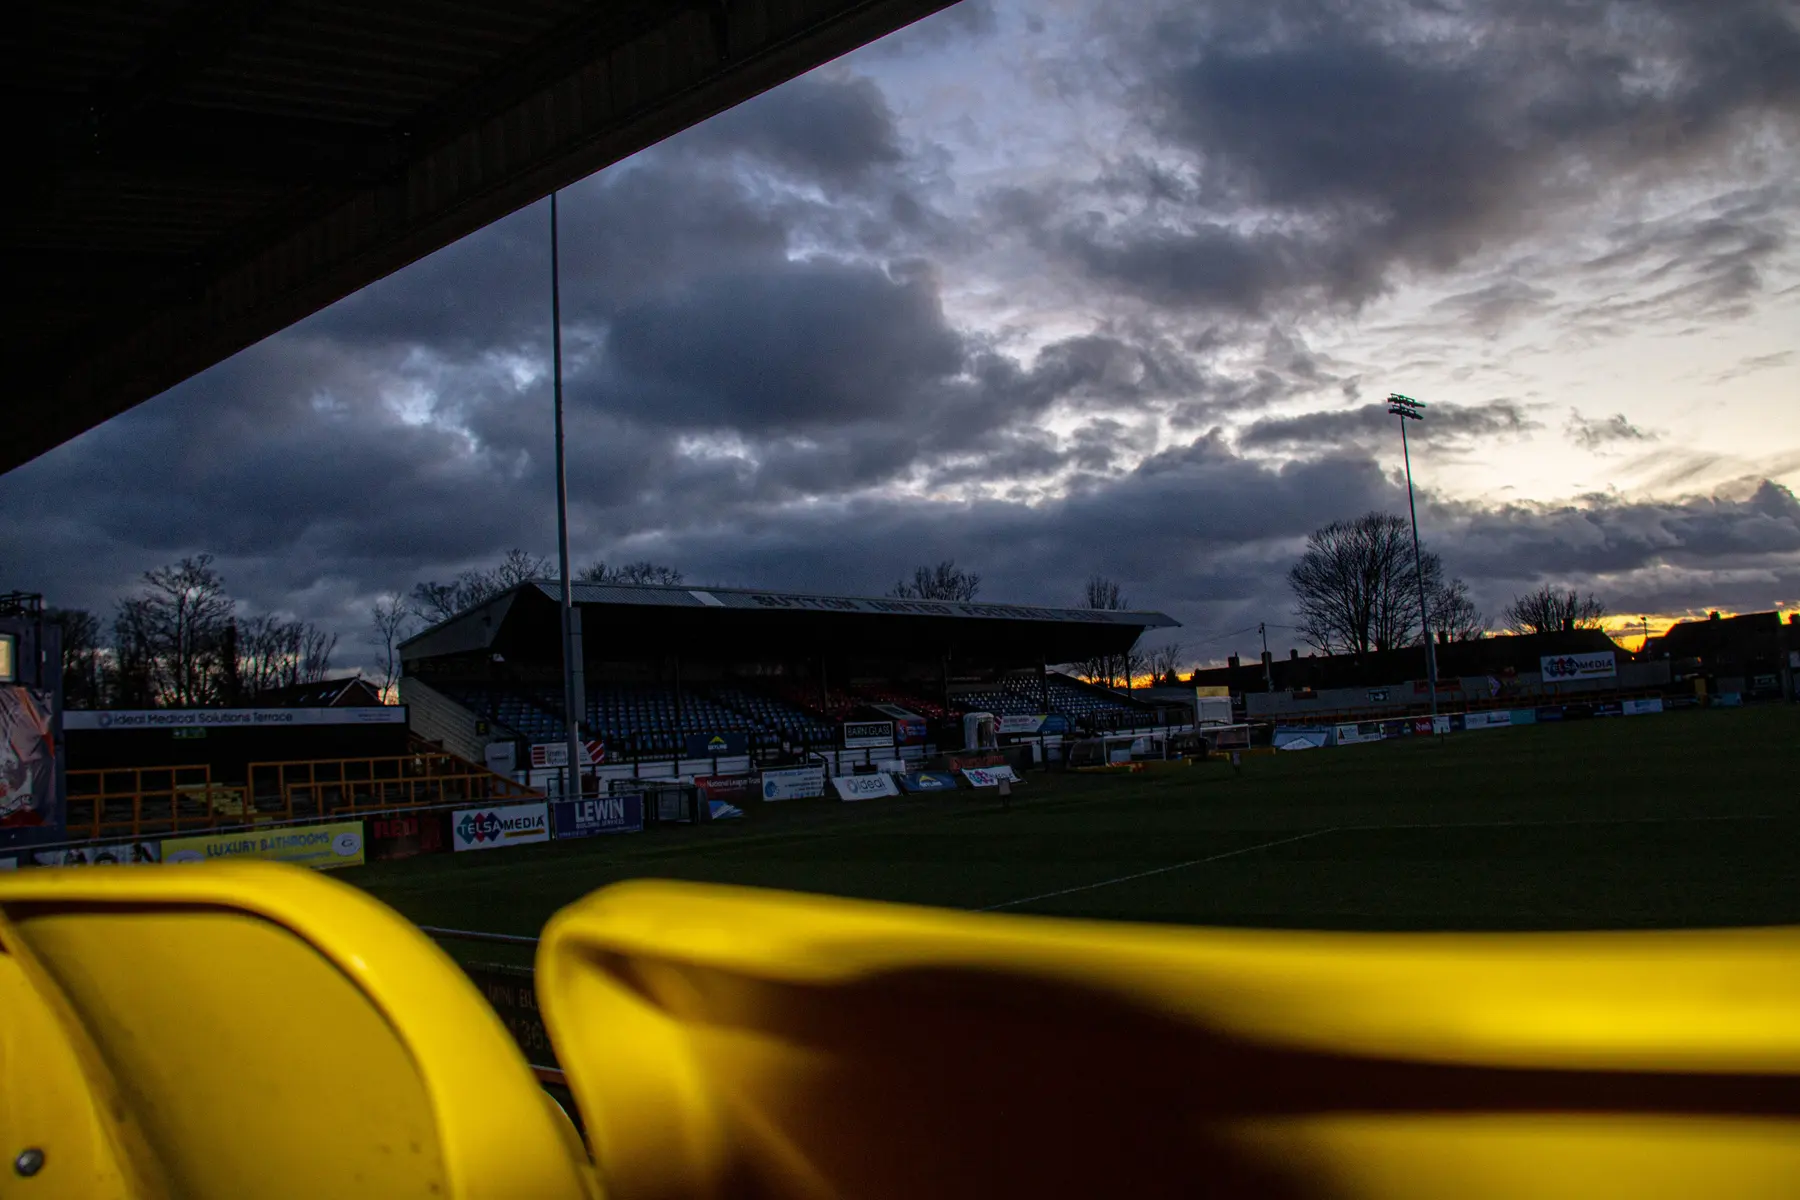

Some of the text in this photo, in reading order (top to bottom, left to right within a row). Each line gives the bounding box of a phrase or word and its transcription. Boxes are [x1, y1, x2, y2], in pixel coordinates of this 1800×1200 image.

[148, 713, 196, 724] Medical
[199, 713, 250, 723] Solutions
[252, 711, 293, 722] Terrace
[574, 797, 625, 823] LEWIN
[459, 815, 545, 836] TELSA MEDIA
[206, 840, 257, 857] LUXURY
[260, 832, 330, 851] BATHROOMS
